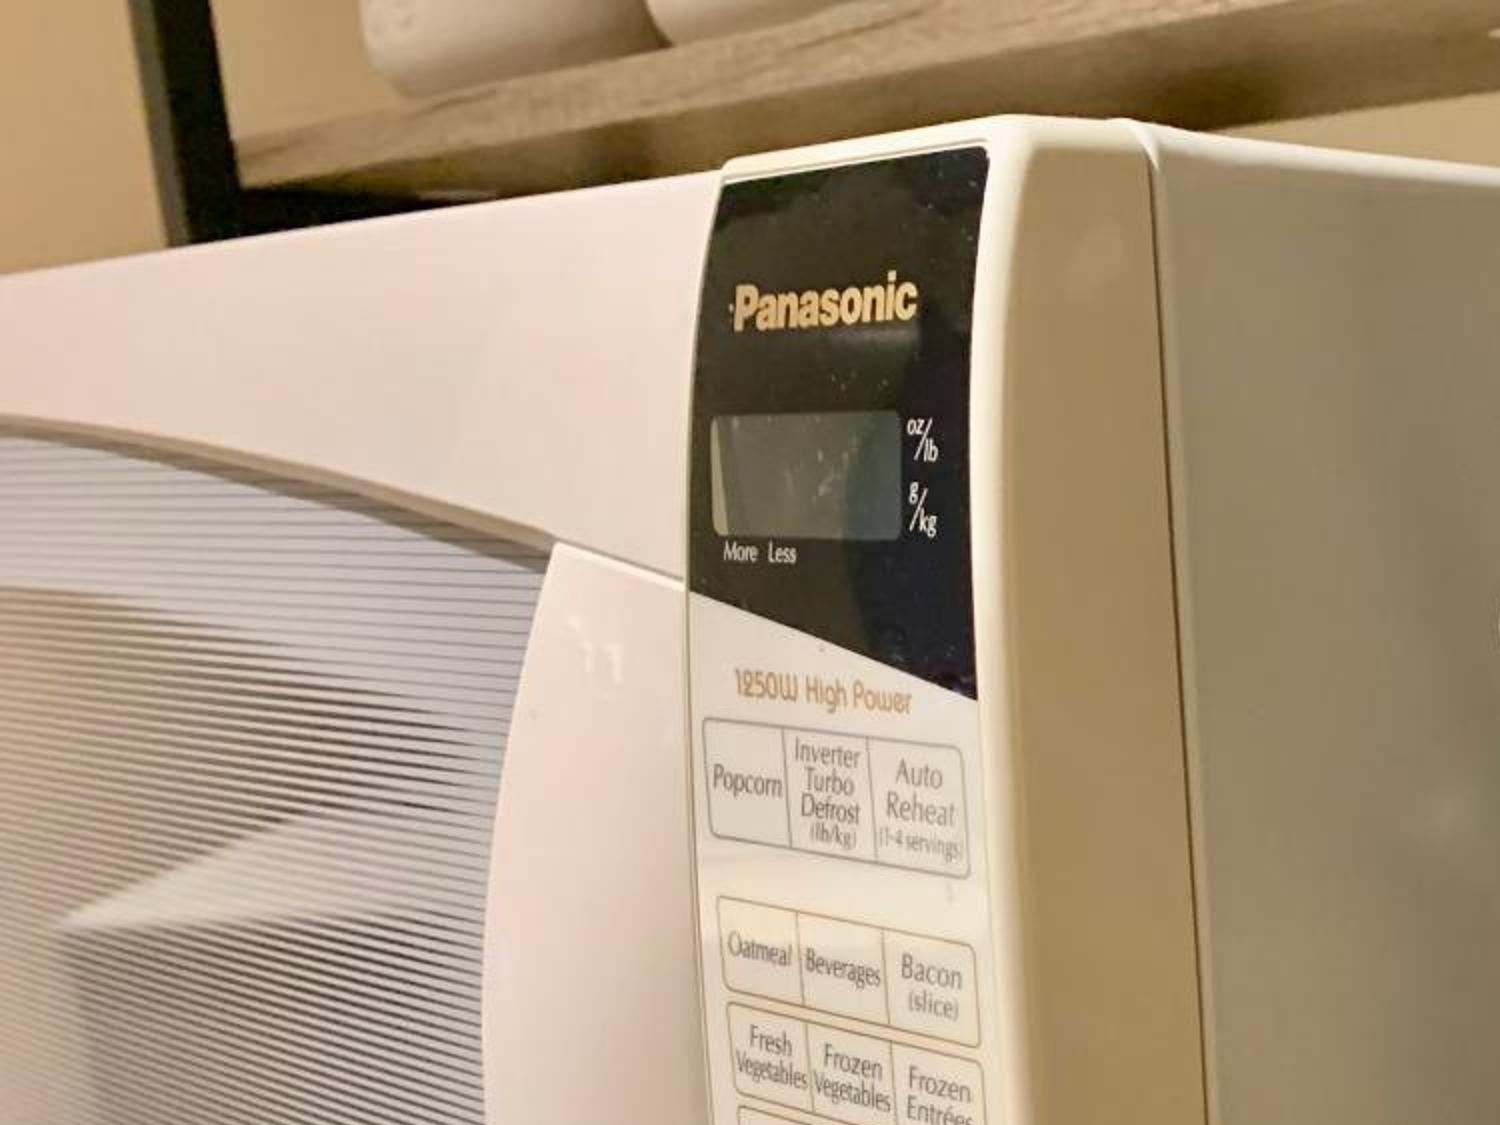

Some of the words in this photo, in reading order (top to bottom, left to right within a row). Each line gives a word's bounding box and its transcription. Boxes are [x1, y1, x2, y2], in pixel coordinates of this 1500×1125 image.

[733, 270, 918, 332] Panasonic
[724, 542, 758, 562] More
[768, 543, 797, 565] Less
[735, 668, 799, 702] 1250W
[806, 674, 847, 714] High
[853, 679, 912, 714] Power
[795, 736, 860, 769] Inverter
[713, 763, 783, 798] Popcorn
[805, 766, 855, 795] Turbo
[896, 758, 943, 790] Auto
[801, 793, 860, 824] Defrost
[886, 791, 955, 827] Reheat
[727, 931, 793, 967] Oatmeal
[805, 948, 881, 989] Beverages
[901, 952, 963, 989] Bacon
[909, 991, 959, 1021] (slice)
[749, 1024, 793, 1056] Fresh
[735, 1050, 808, 1090] Vegetables
[823, 1043, 883, 1081] Frozen
[813, 1070, 891, 1113] Vegetables
[909, 1065, 971, 1104] Frozen
